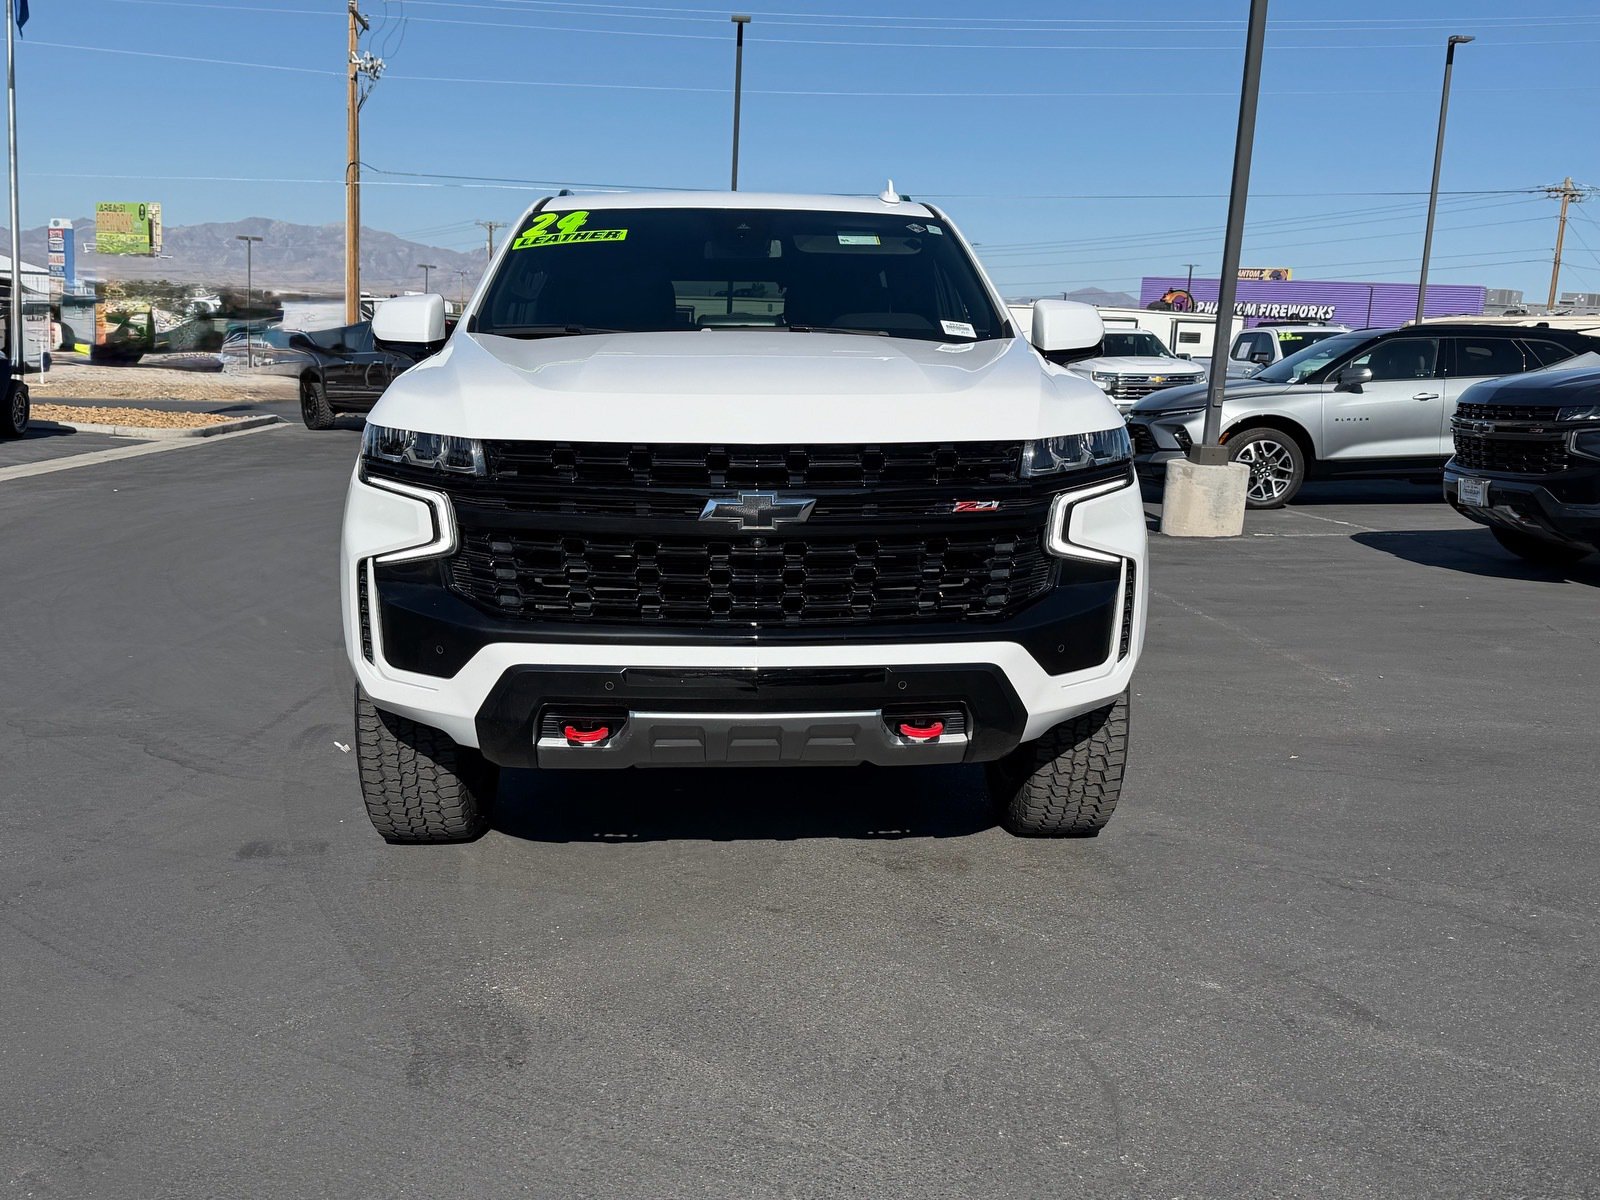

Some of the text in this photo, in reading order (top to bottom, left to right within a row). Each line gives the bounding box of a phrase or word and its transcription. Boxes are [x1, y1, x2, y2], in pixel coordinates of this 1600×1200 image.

[522, 211, 589, 237] 24
[517, 231, 622, 247] LEATHER
[1258, 303, 1336, 320] FIREWORKS
[952, 500, 1000, 512] Z71
